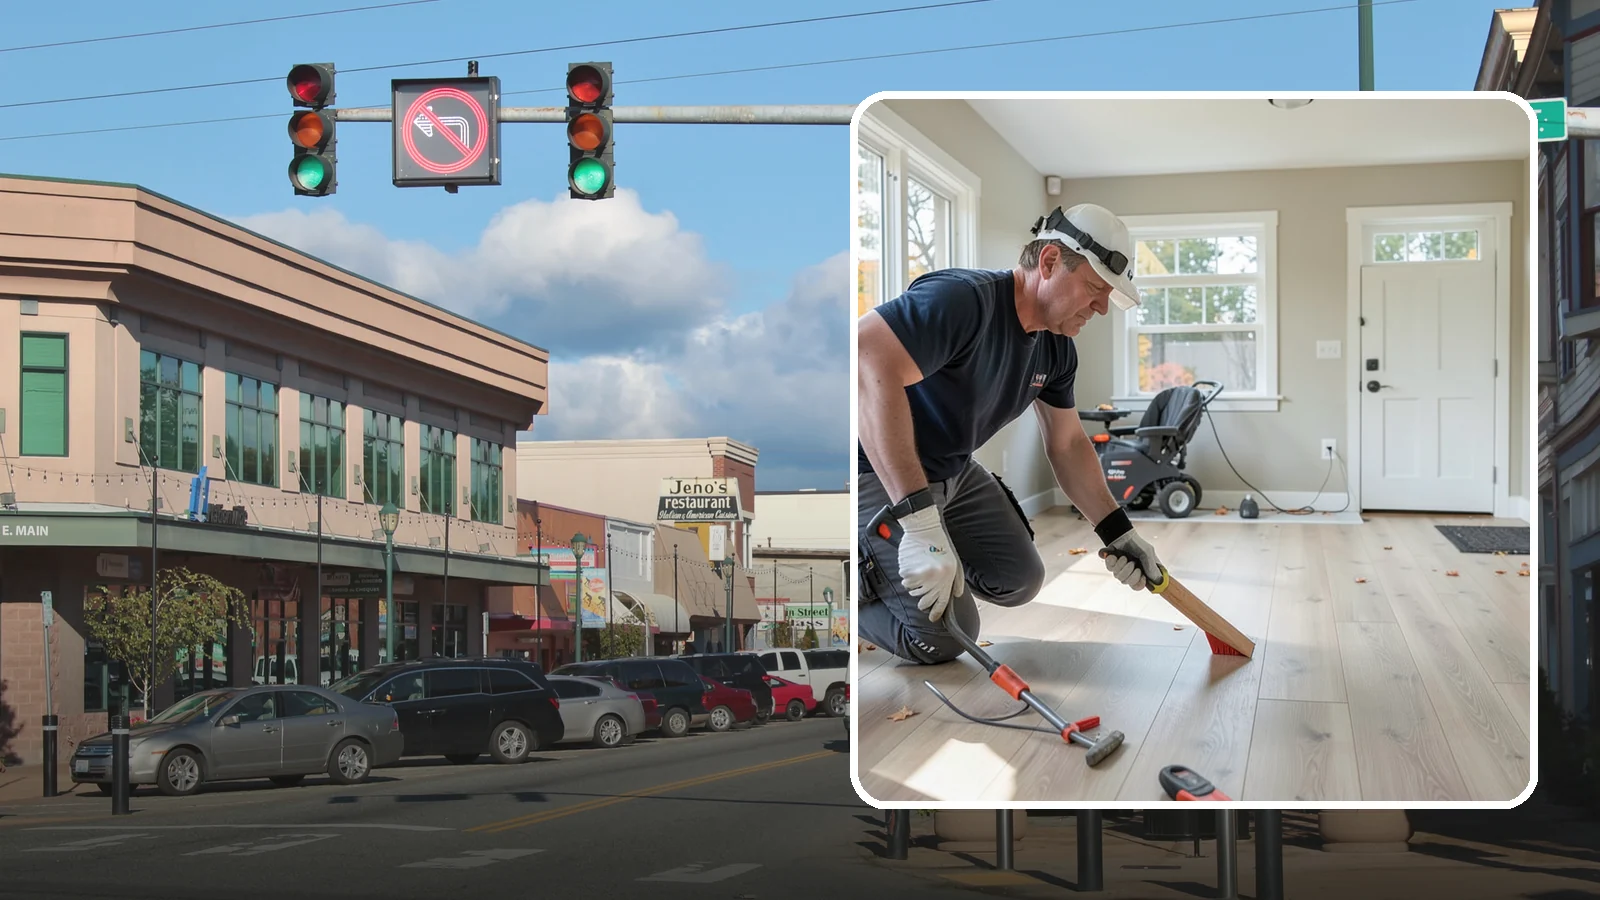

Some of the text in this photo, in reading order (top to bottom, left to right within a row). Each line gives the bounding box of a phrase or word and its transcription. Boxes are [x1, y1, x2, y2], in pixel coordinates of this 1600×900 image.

[669, 480, 728, 495] Jeno's
[665, 496, 731, 509] restaurant
[658, 509, 681, 519] Italian
[685, 509, 714, 519] American
[715, 509, 737, 519] Cuisine
[2, 525, 49, 536] E. MAIN
[797, 607, 828, 617] Street
